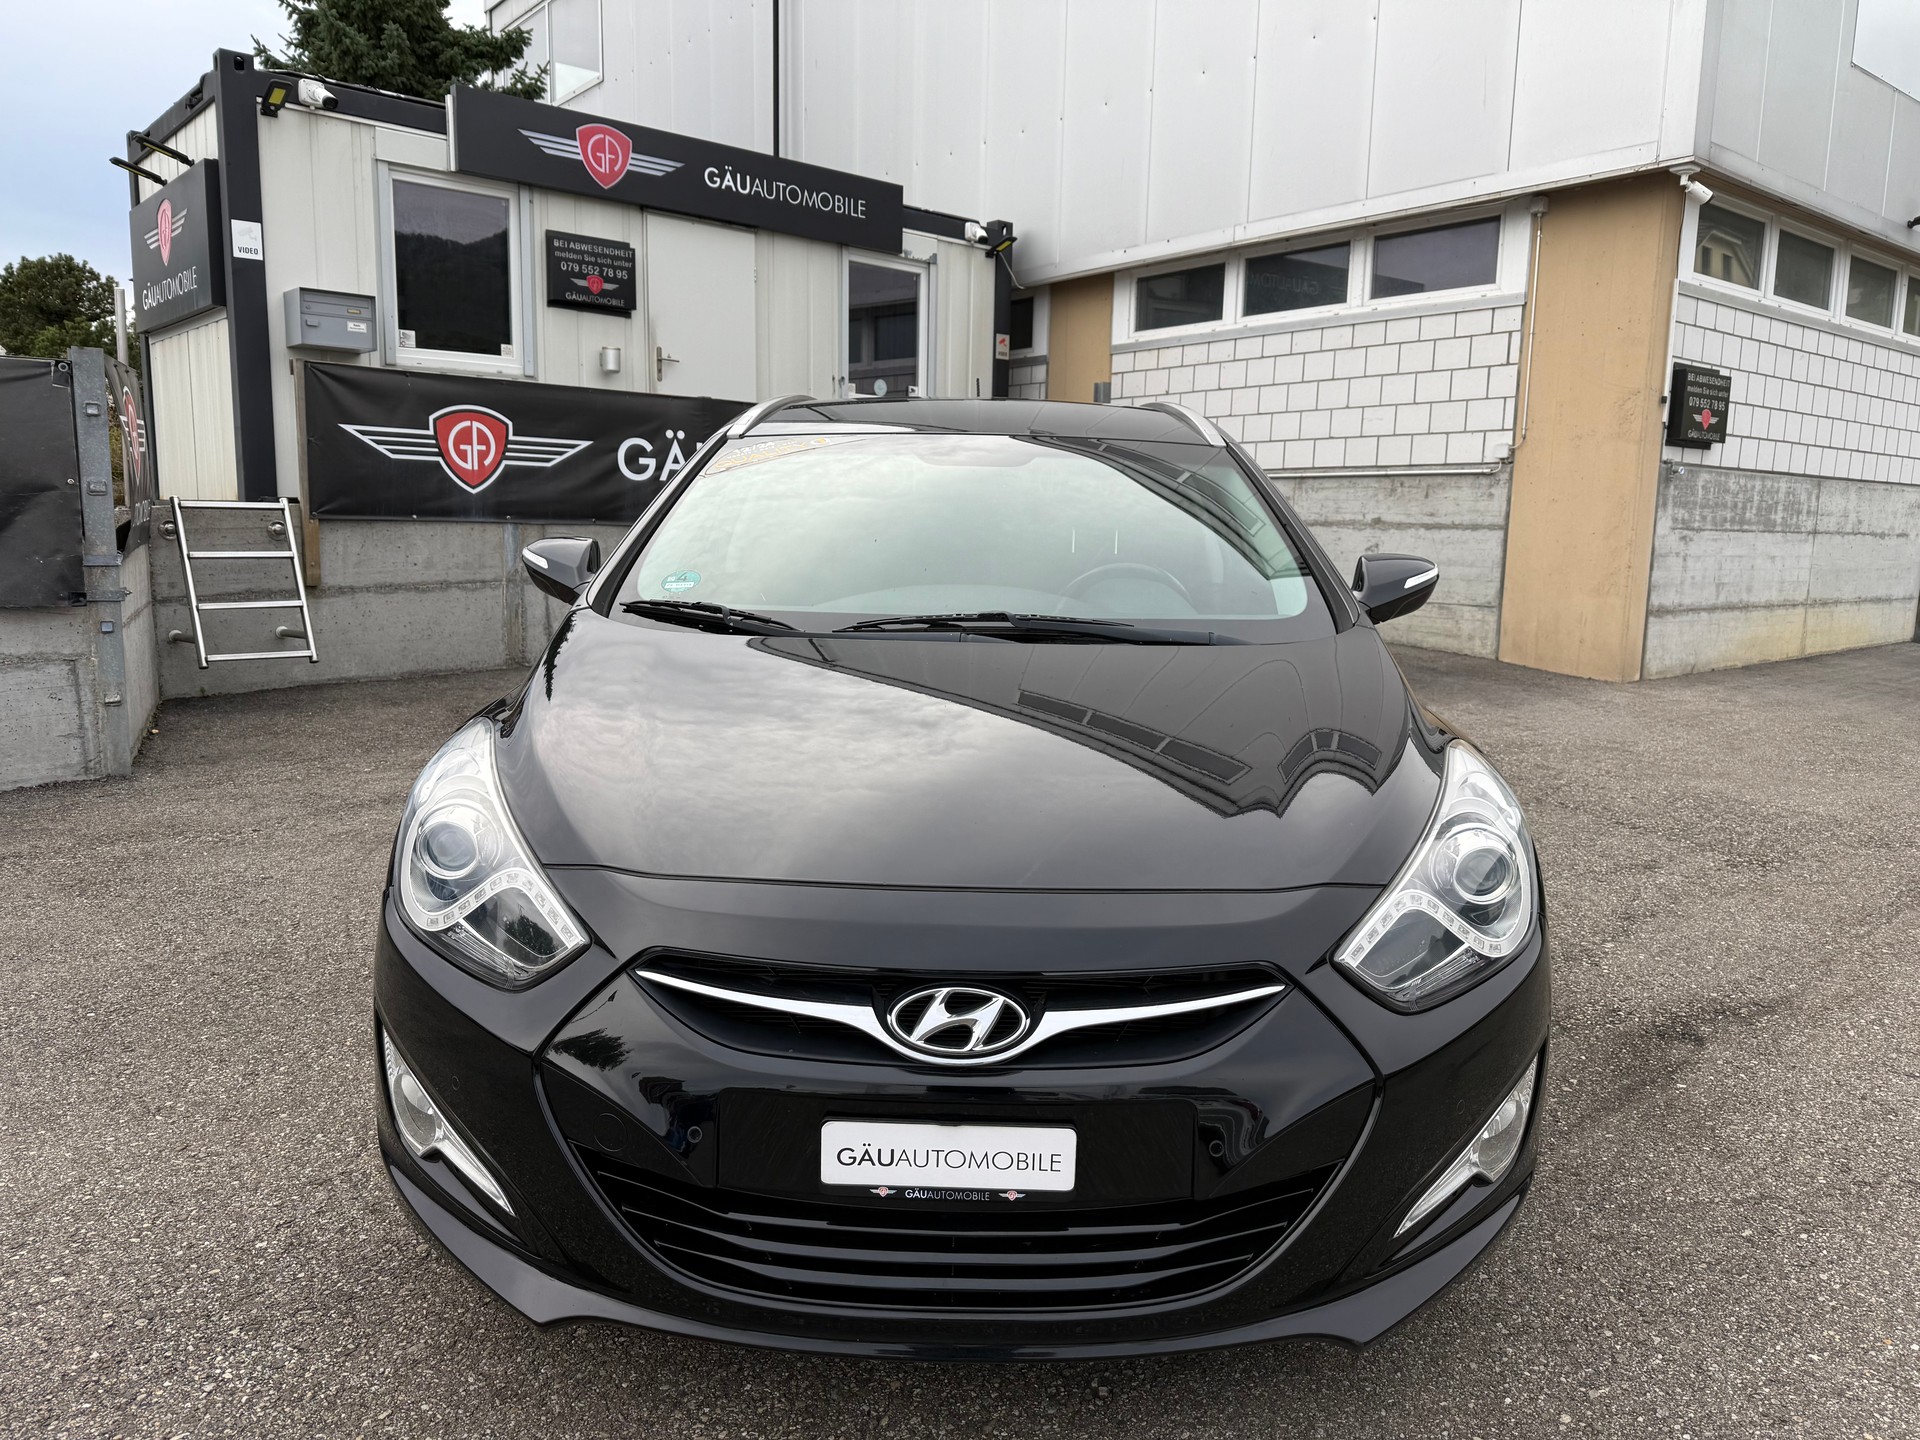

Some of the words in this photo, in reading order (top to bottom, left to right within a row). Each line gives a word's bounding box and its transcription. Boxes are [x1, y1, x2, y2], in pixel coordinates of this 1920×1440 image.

[703, 165, 867, 219] GÄUAUTOMOBILE
[237, 246, 259, 255] VIDEO
[553, 239, 568, 247] BEI
[569, 241, 633, 258] ABWESENDHEIT
[554, 250, 583, 260] melden
[583, 254, 596, 262] Sie
[596, 256, 612, 265] sich
[613, 260, 633, 268] unter
[560, 261, 580, 272] 079
[581, 264, 600, 276] 552
[602, 267, 614, 278] 78
[615, 269, 628, 280] 95
[142, 266, 198, 311] GÄUAUTOMOBILE
[565, 291, 625, 307] GÄUAUTOMOBILE
[1689, 396, 1700, 407] 079
[1700, 398, 1711, 409] 552
[1711, 399, 1718, 410] 78
[617, 429, 703, 482] GÄ
[836, 1142, 1062, 1173] GÄUAUTOMOBILE
[905, 1187, 990, 1201] GÄUAUTOMOBILE
